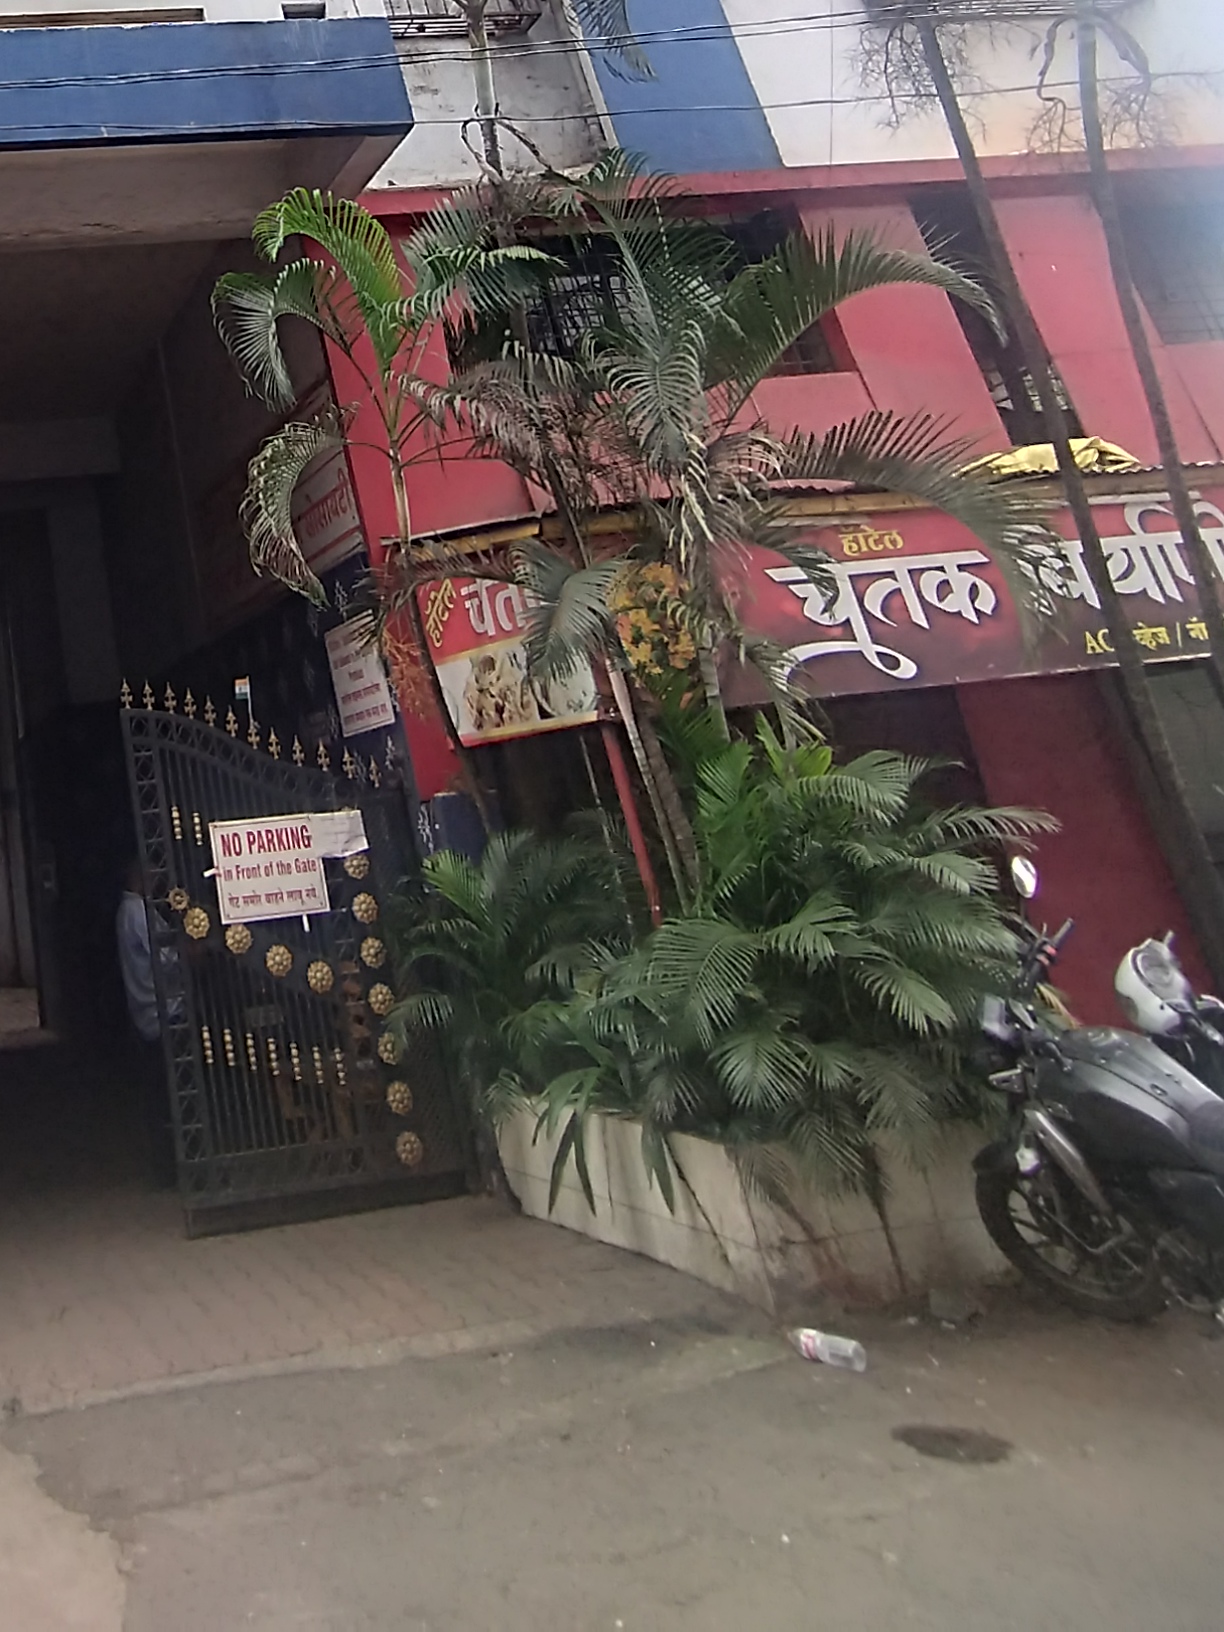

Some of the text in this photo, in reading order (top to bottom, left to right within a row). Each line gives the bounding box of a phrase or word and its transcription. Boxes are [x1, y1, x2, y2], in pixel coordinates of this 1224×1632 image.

[220, 824, 312, 858] NO PARKING
[236, 864, 262, 881] Front
[264, 862, 274, 878] of
[276, 859, 293, 877] the
[294, 857, 318, 875] Gate
